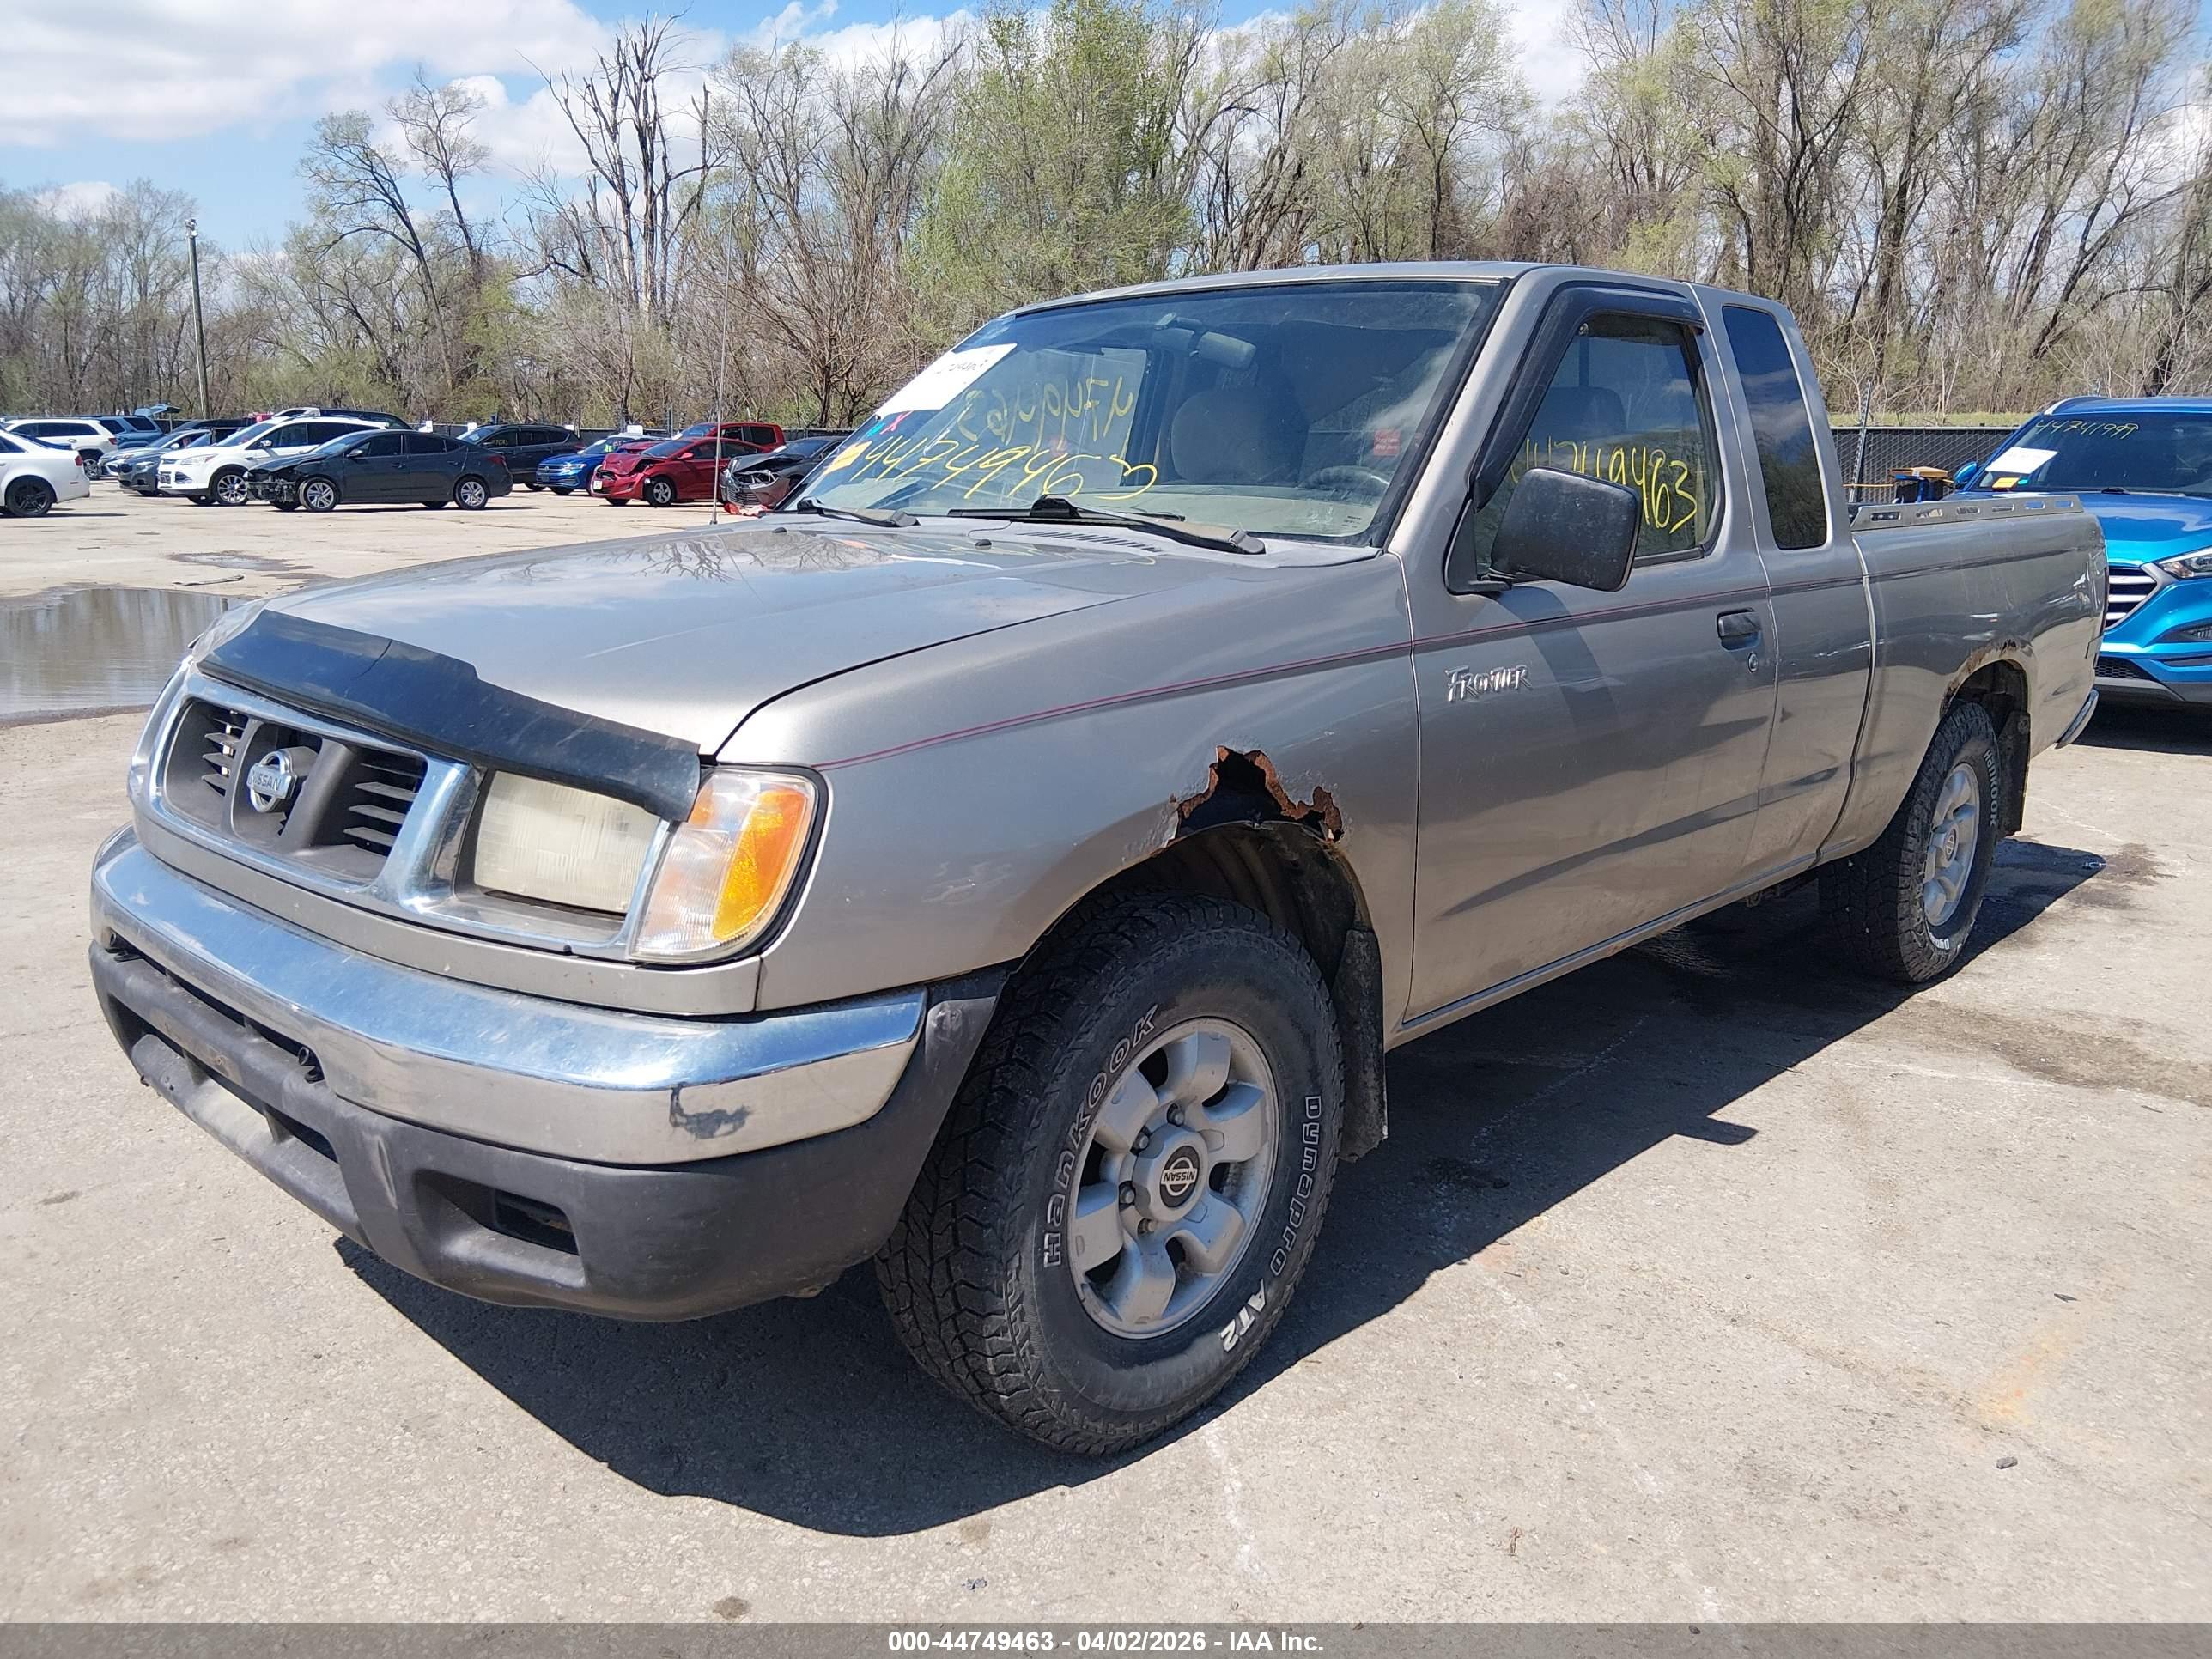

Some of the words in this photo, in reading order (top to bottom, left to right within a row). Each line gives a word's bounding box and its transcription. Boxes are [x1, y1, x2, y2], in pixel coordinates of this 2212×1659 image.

[848, 434, 1158, 501] 44749463
[1163, 1170, 1196, 1183] NISSAN
[1219, 1278, 1267, 1352] AT2
